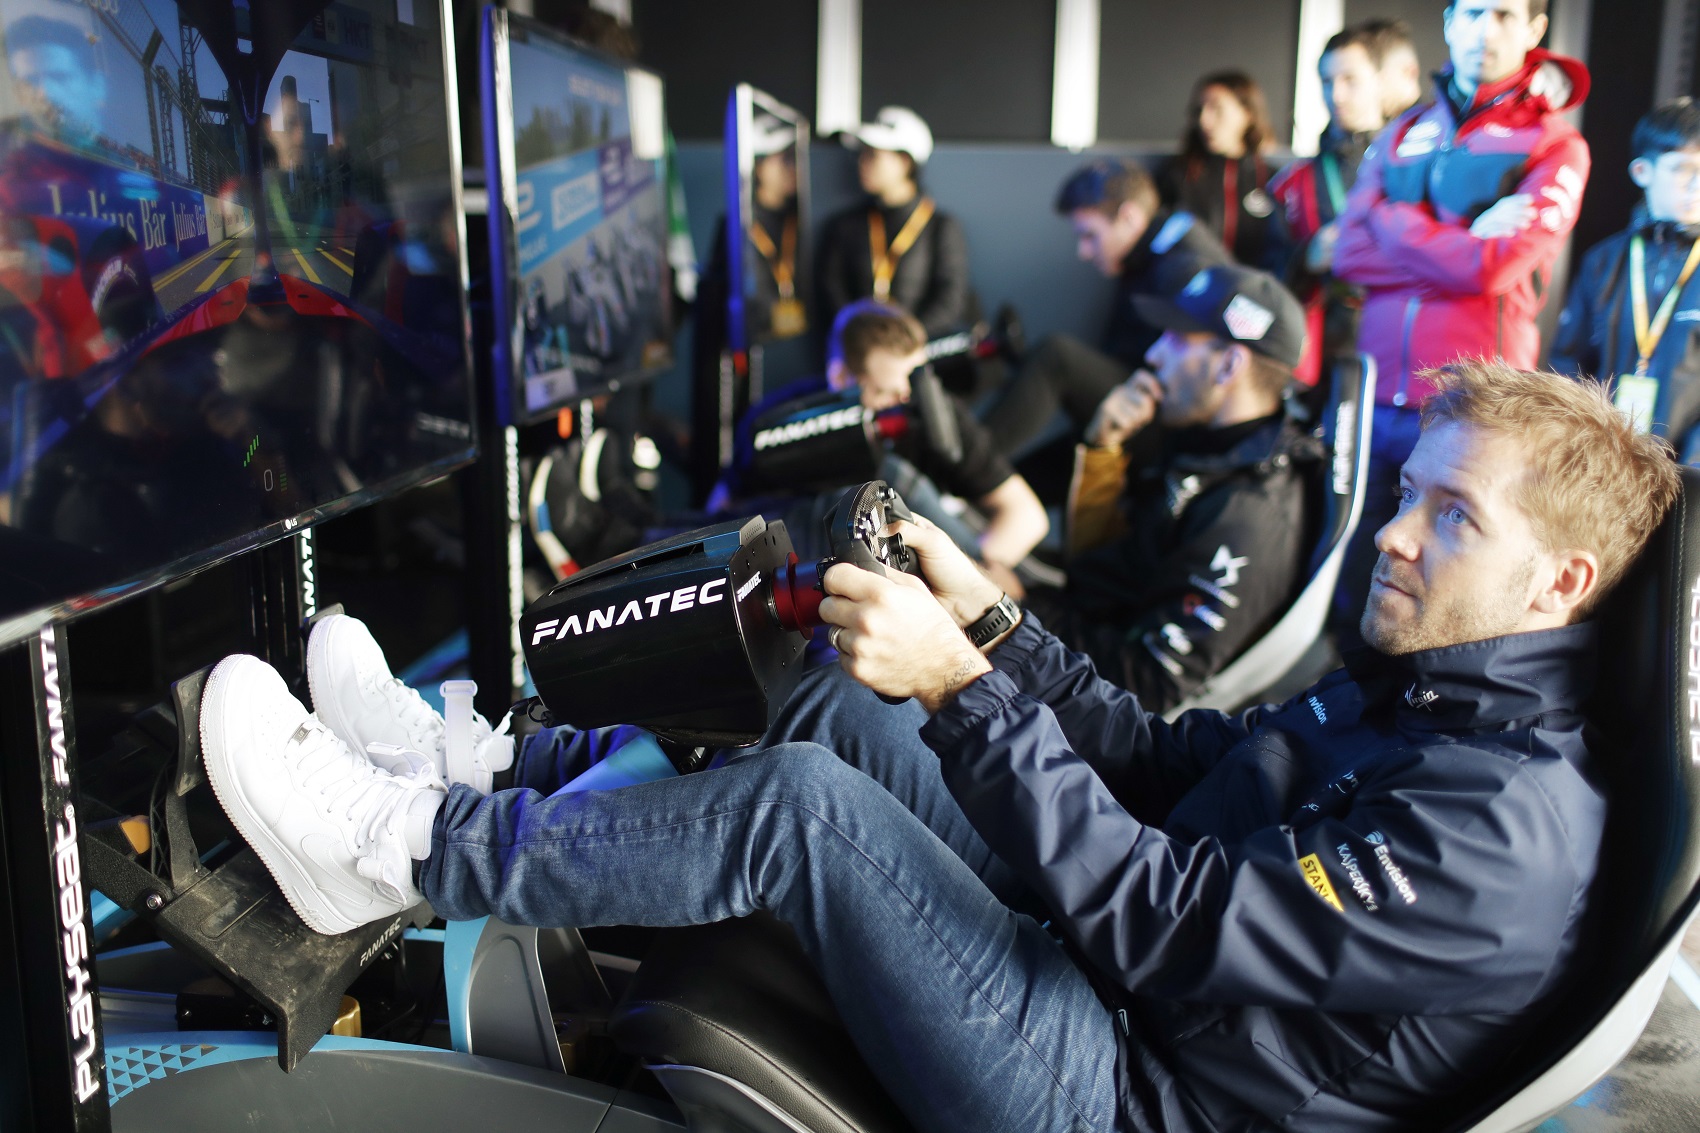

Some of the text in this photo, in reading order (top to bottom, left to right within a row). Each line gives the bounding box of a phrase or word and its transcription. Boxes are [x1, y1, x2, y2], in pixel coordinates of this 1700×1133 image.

[48, 184, 167, 251] Jlius Bär
[171, 201, 196, 252] Julius
[531, 577, 727, 646] FANATEC
[1308, 696, 1327, 725] nvision
[1404, 683, 1439, 712] Virgin
[1374, 844, 1417, 906] Envision
[360, 916, 402, 967] FANATEC
